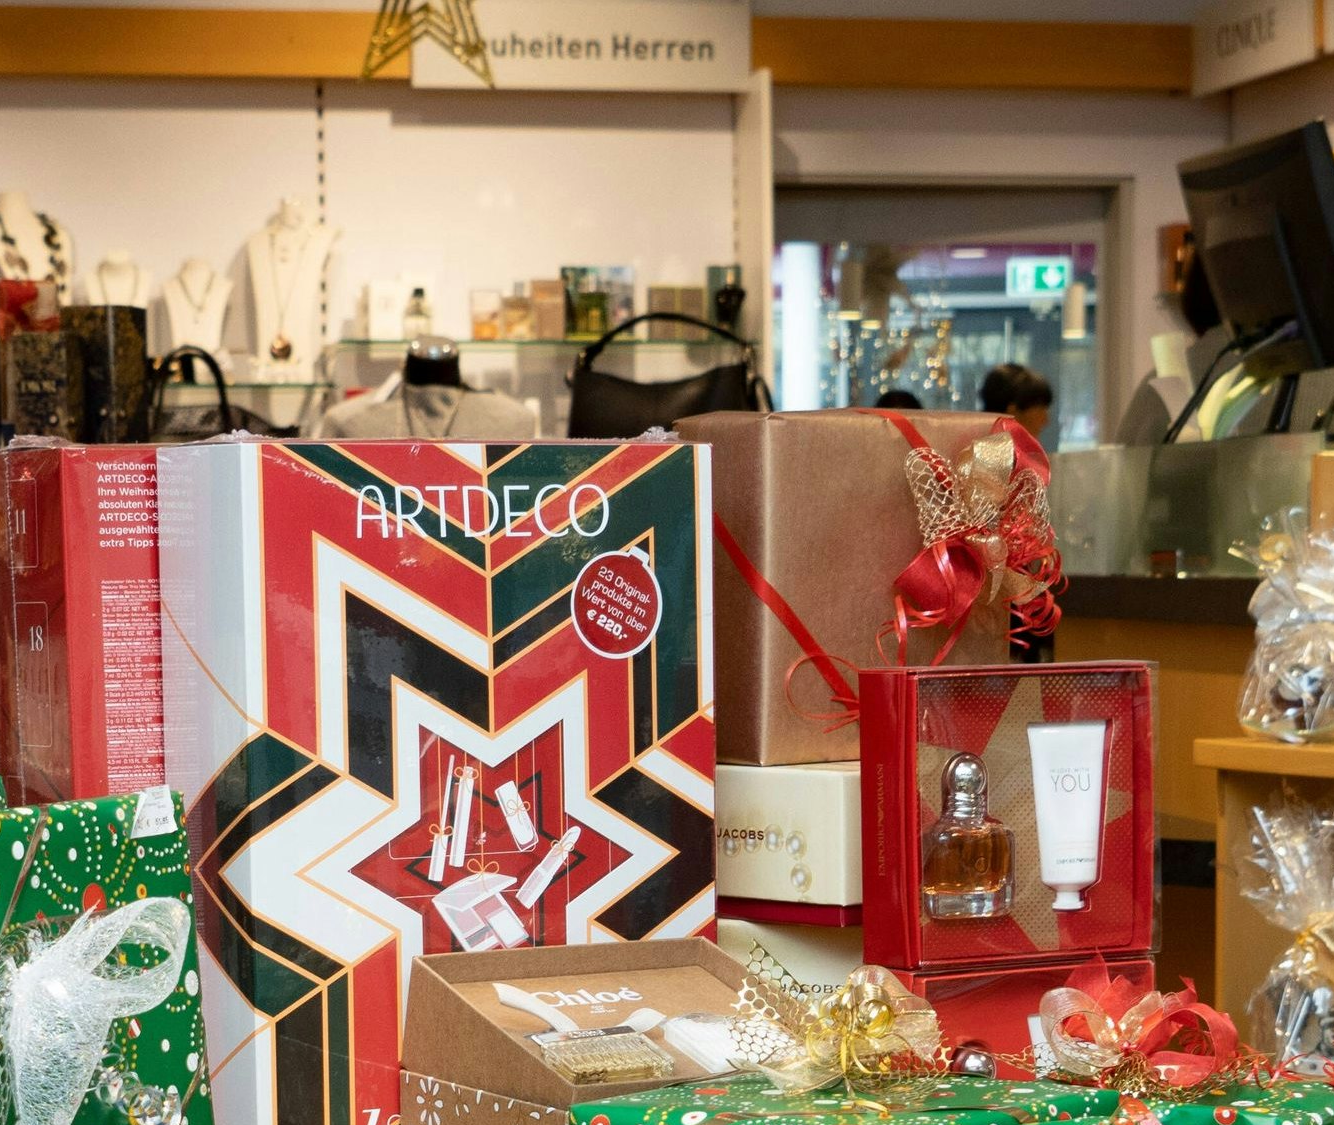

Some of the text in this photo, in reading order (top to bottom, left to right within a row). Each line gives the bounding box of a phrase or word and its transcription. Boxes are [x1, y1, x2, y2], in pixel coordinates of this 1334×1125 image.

[483, 31, 715, 61] uheiten Herren
[96, 461, 157, 471] Verschönern
[97, 487, 117, 496] Ihre
[98, 500, 144, 509] absoluten
[355, 483, 610, 540] ARTDECO
[14, 509, 27, 535] 11
[100, 538, 154, 548] extra Tipps
[598, 566, 651, 604] 23 Original-
[581, 586, 647, 633] Wert von über
[591, 580, 648, 618] produkte im
[586, 609, 597, 621] €
[29, 625, 44, 652] 18
[1050, 773, 1091, 792] YOU
[717, 827, 765, 841] JACOBS
[531, 986, 643, 1008] Chloé
